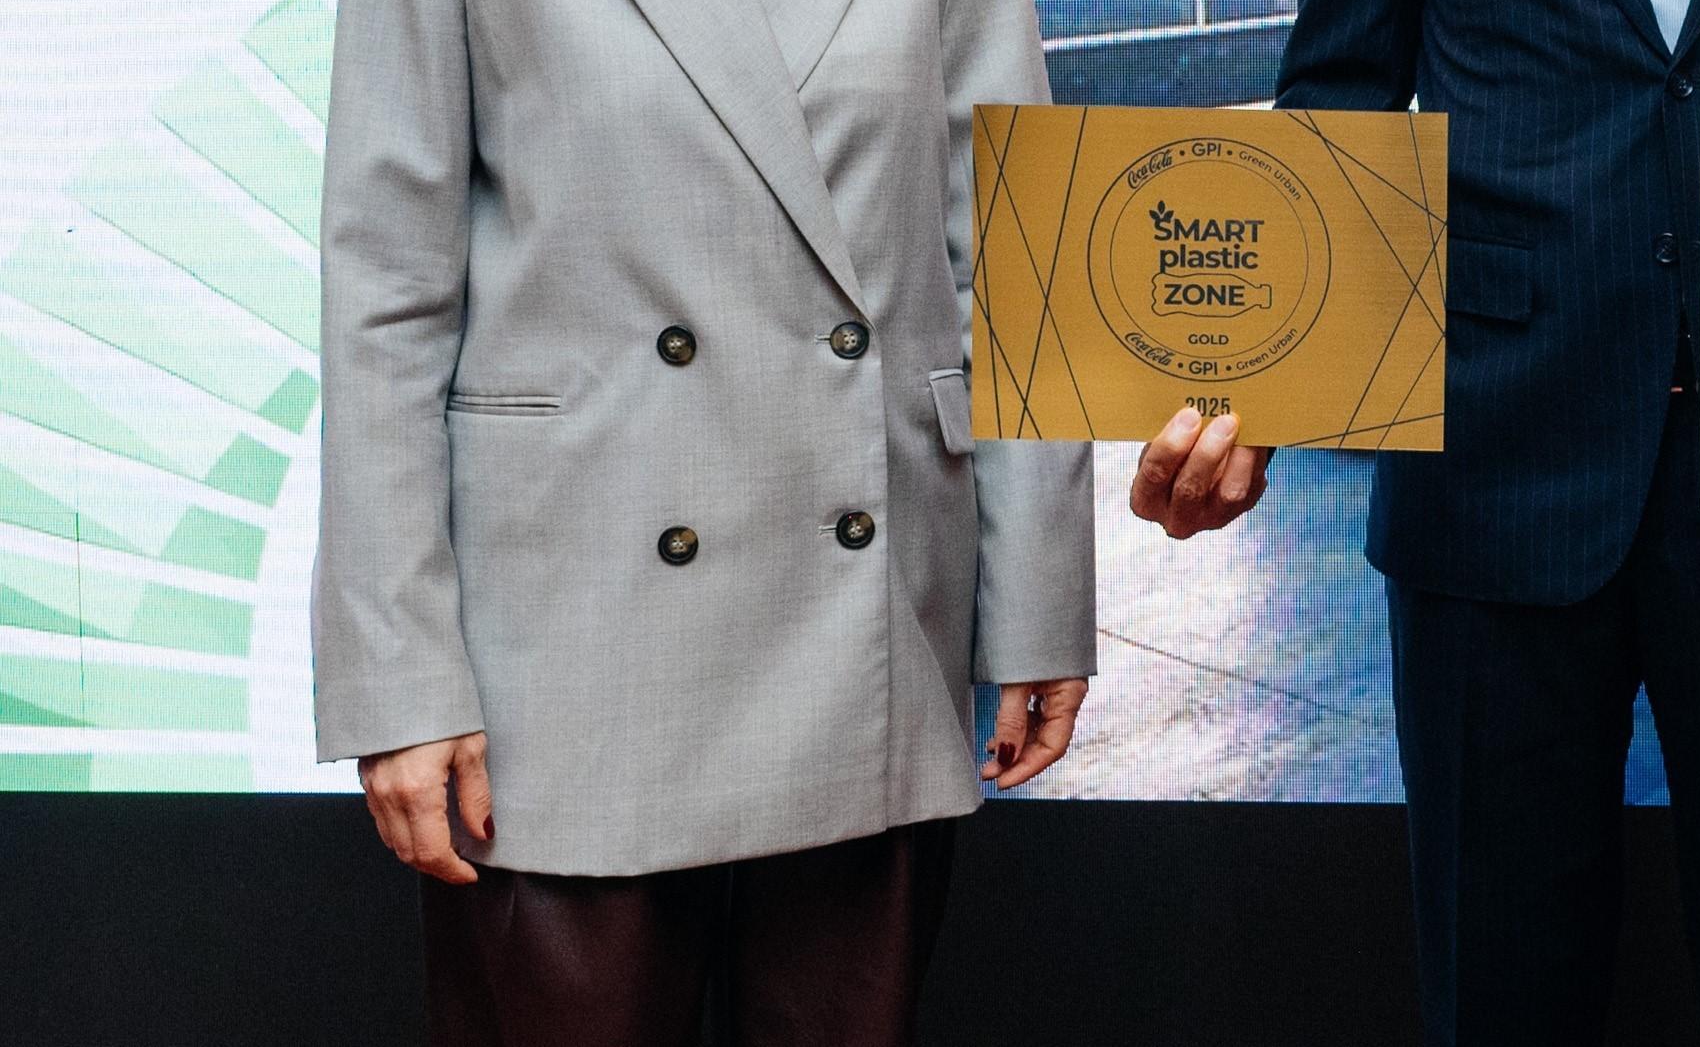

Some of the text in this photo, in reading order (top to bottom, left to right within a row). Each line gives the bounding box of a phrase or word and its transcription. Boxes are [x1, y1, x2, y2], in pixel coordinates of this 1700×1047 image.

[1191, 142, 1222, 157] GPI
[1238, 150, 1273, 174] Green
[1274, 169, 1302, 201] Urban
[1154, 218, 1265, 243] SMART
[1159, 243, 1259, 274] plastic
[1163, 283, 1246, 307] ZONE
[1188, 333, 1229, 345] GOLD
[1188, 360, 1219, 376] GPI
[1236, 353, 1270, 371] Green
[1268, 327, 1298, 356] Urban
